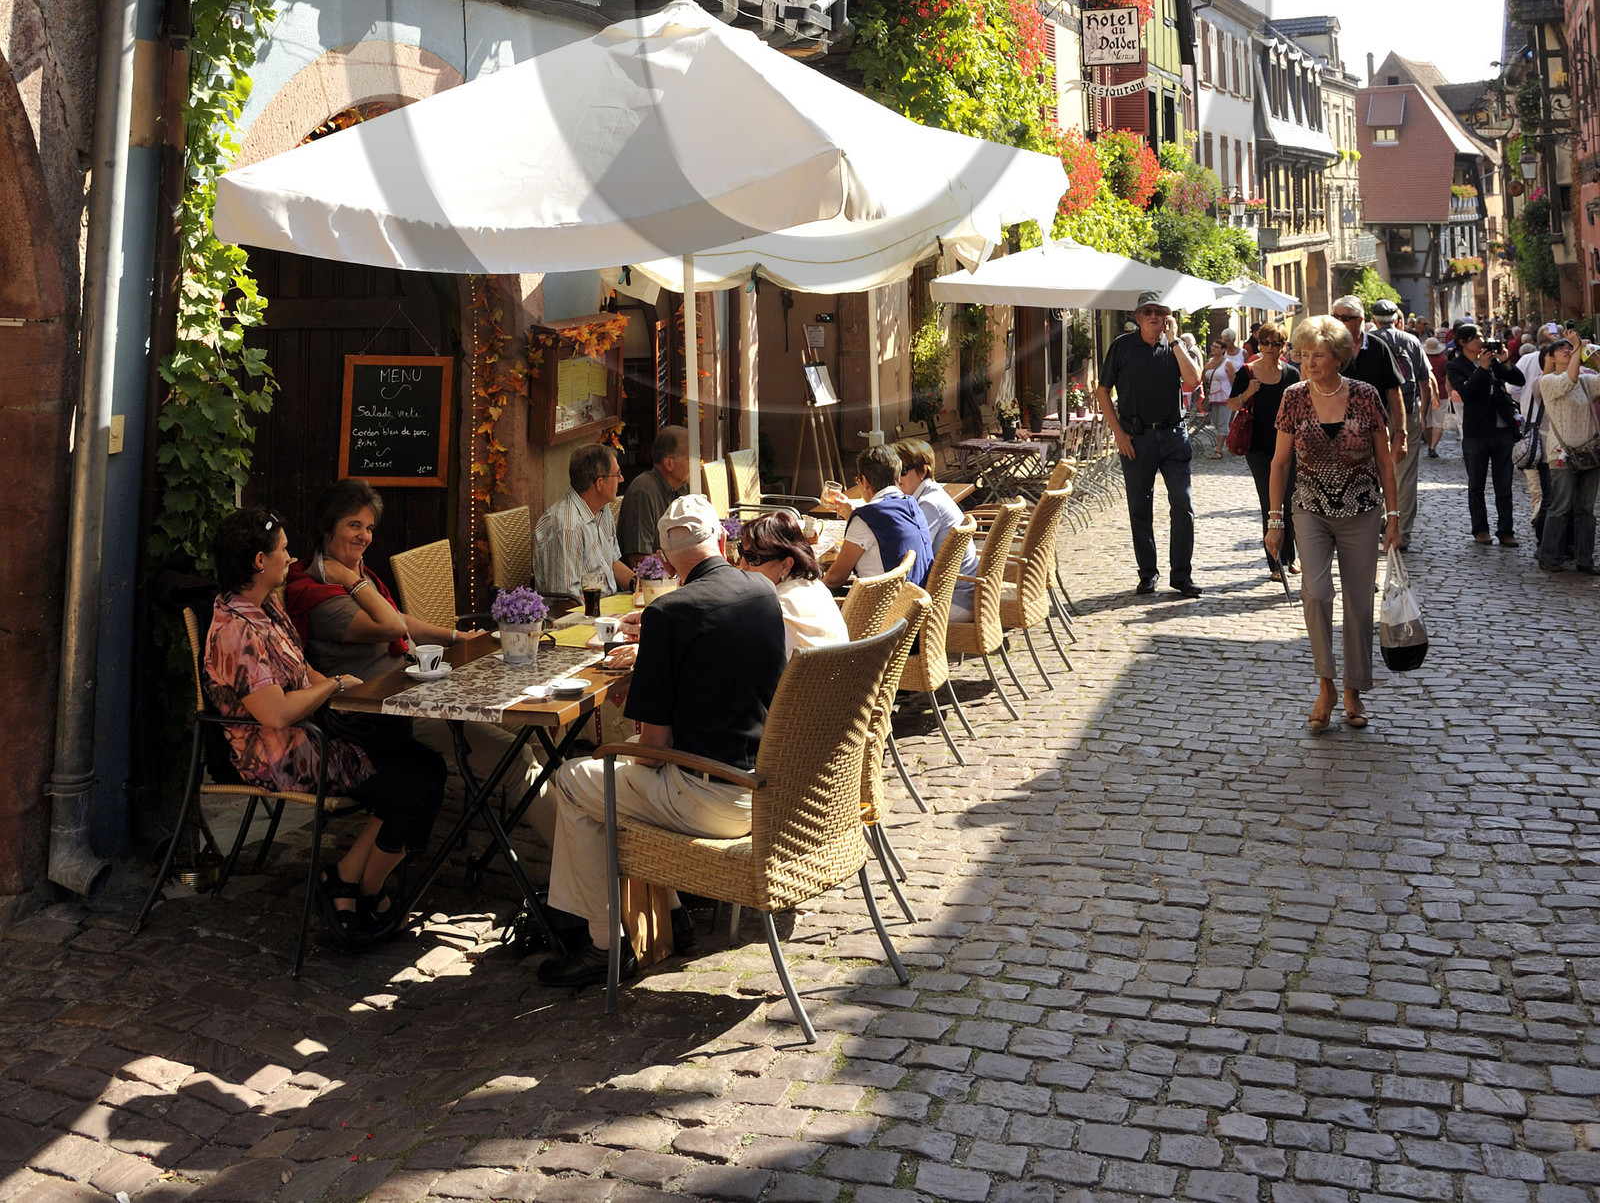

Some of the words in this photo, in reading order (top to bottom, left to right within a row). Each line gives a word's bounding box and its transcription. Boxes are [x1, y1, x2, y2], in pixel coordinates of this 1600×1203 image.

[1085, 10, 1134, 29] Hôtel
[1111, 27, 1126, 35] au
[1099, 36, 1137, 50] Dolder
[1081, 79, 1145, 97] Restaurant
[380, 368, 422, 383] MENU
[352, 427, 380, 437] Cordon
[401, 426, 411, 436] de
